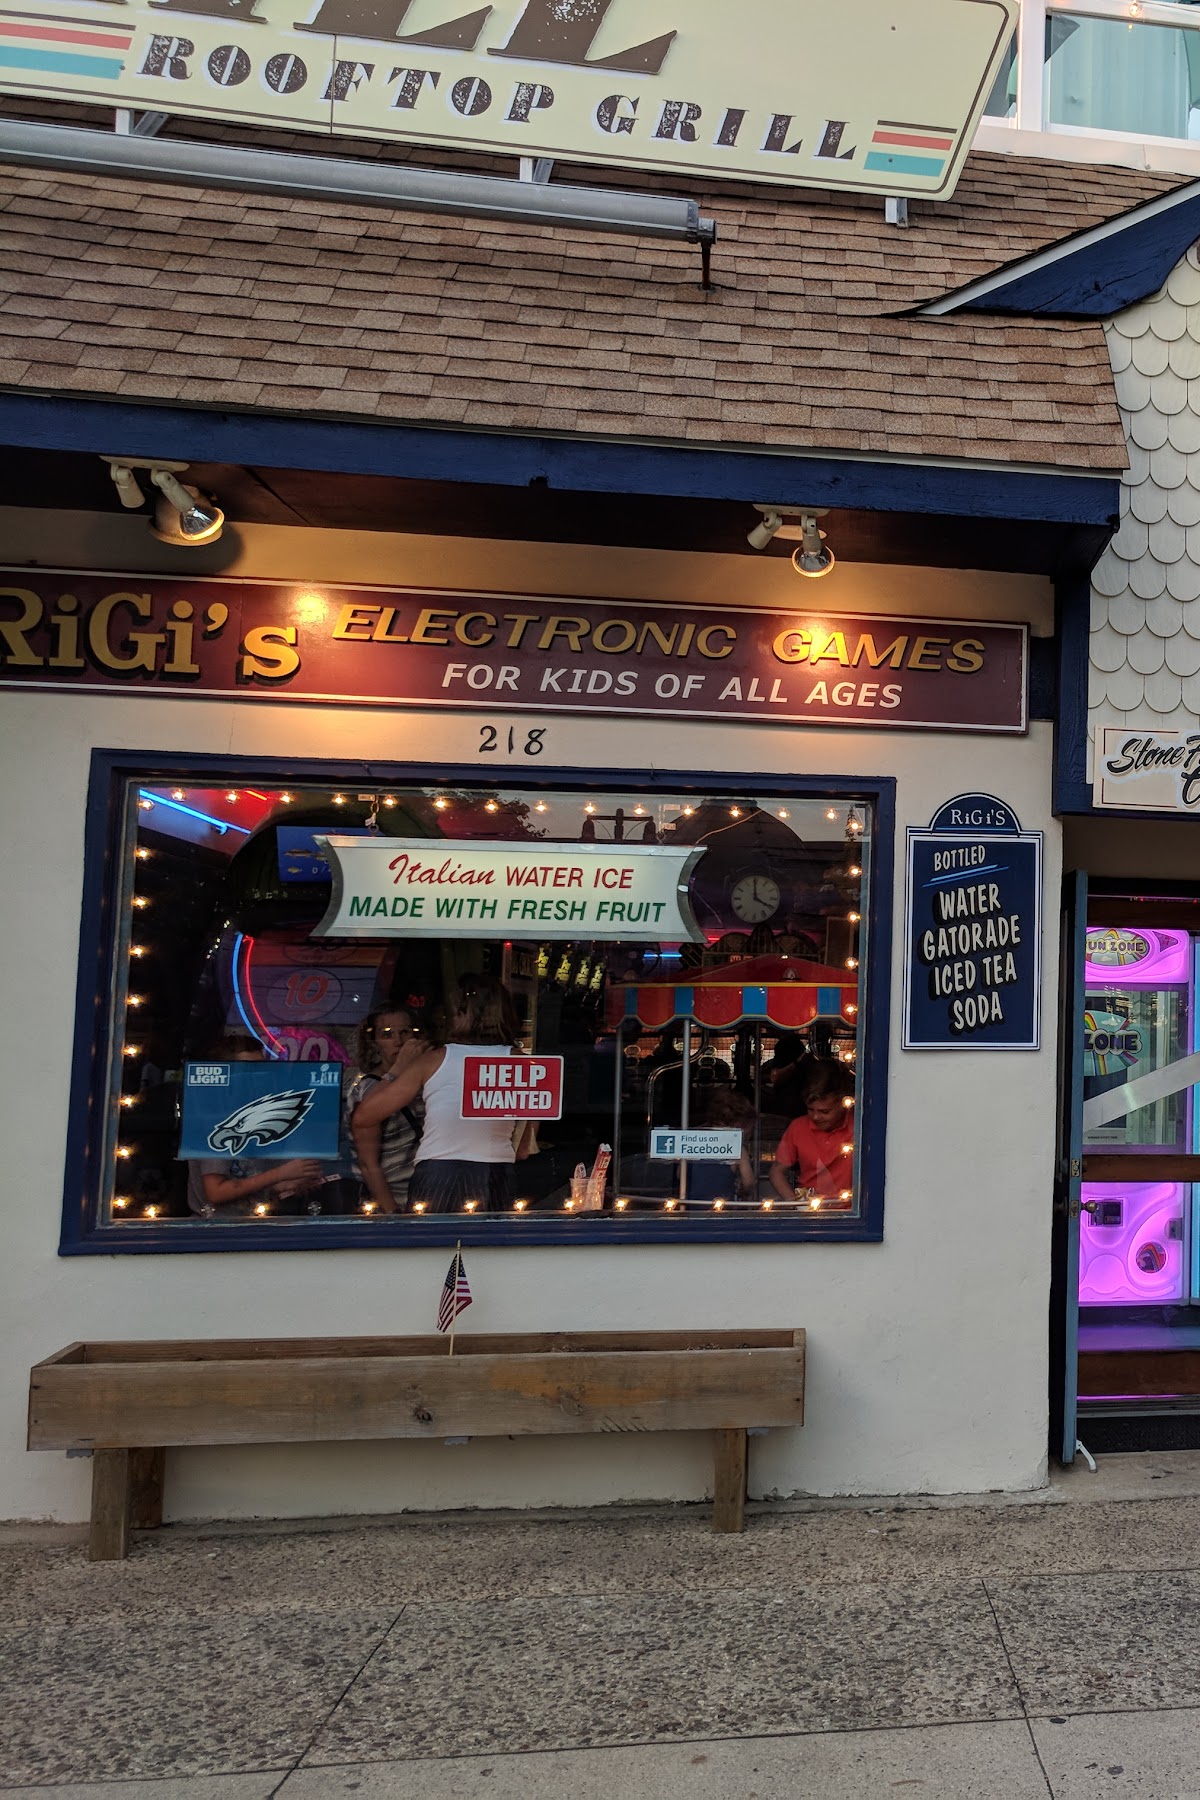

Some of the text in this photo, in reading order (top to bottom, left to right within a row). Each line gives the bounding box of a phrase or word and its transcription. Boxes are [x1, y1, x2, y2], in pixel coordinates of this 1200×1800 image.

[136, 33, 556, 124] ROOFTOP
[597, 94, 858, 161] GRILL
[332, 603, 986, 673] ELECTRONIC GAMES
[442, 663, 903, 709] FOR KIDS OF ALL AGES
[478, 726, 548, 757] 218
[1107, 737, 1185, 773] Stone
[388, 853, 634, 889] Italian WATER ICE
[934, 845, 986, 872] BOTTLED
[349, 896, 666, 922] MADE WITH FRESH FRUIT
[940, 883, 1002, 921] WATER
[923, 914, 1021, 961] GATORADE
[1110, 942, 1144, 951] ZONE
[285, 974, 329, 1008] 10
[934, 952, 1018, 996] ICED TEA
[953, 991, 1003, 1030] SODA
[190, 1075, 227, 1084] LIGHT
[195, 1066, 223, 1076] BUD
[479, 1064, 546, 1088] HELP
[471, 1090, 552, 1111] WANTED
[682, 1144, 738, 1154] Facebook
